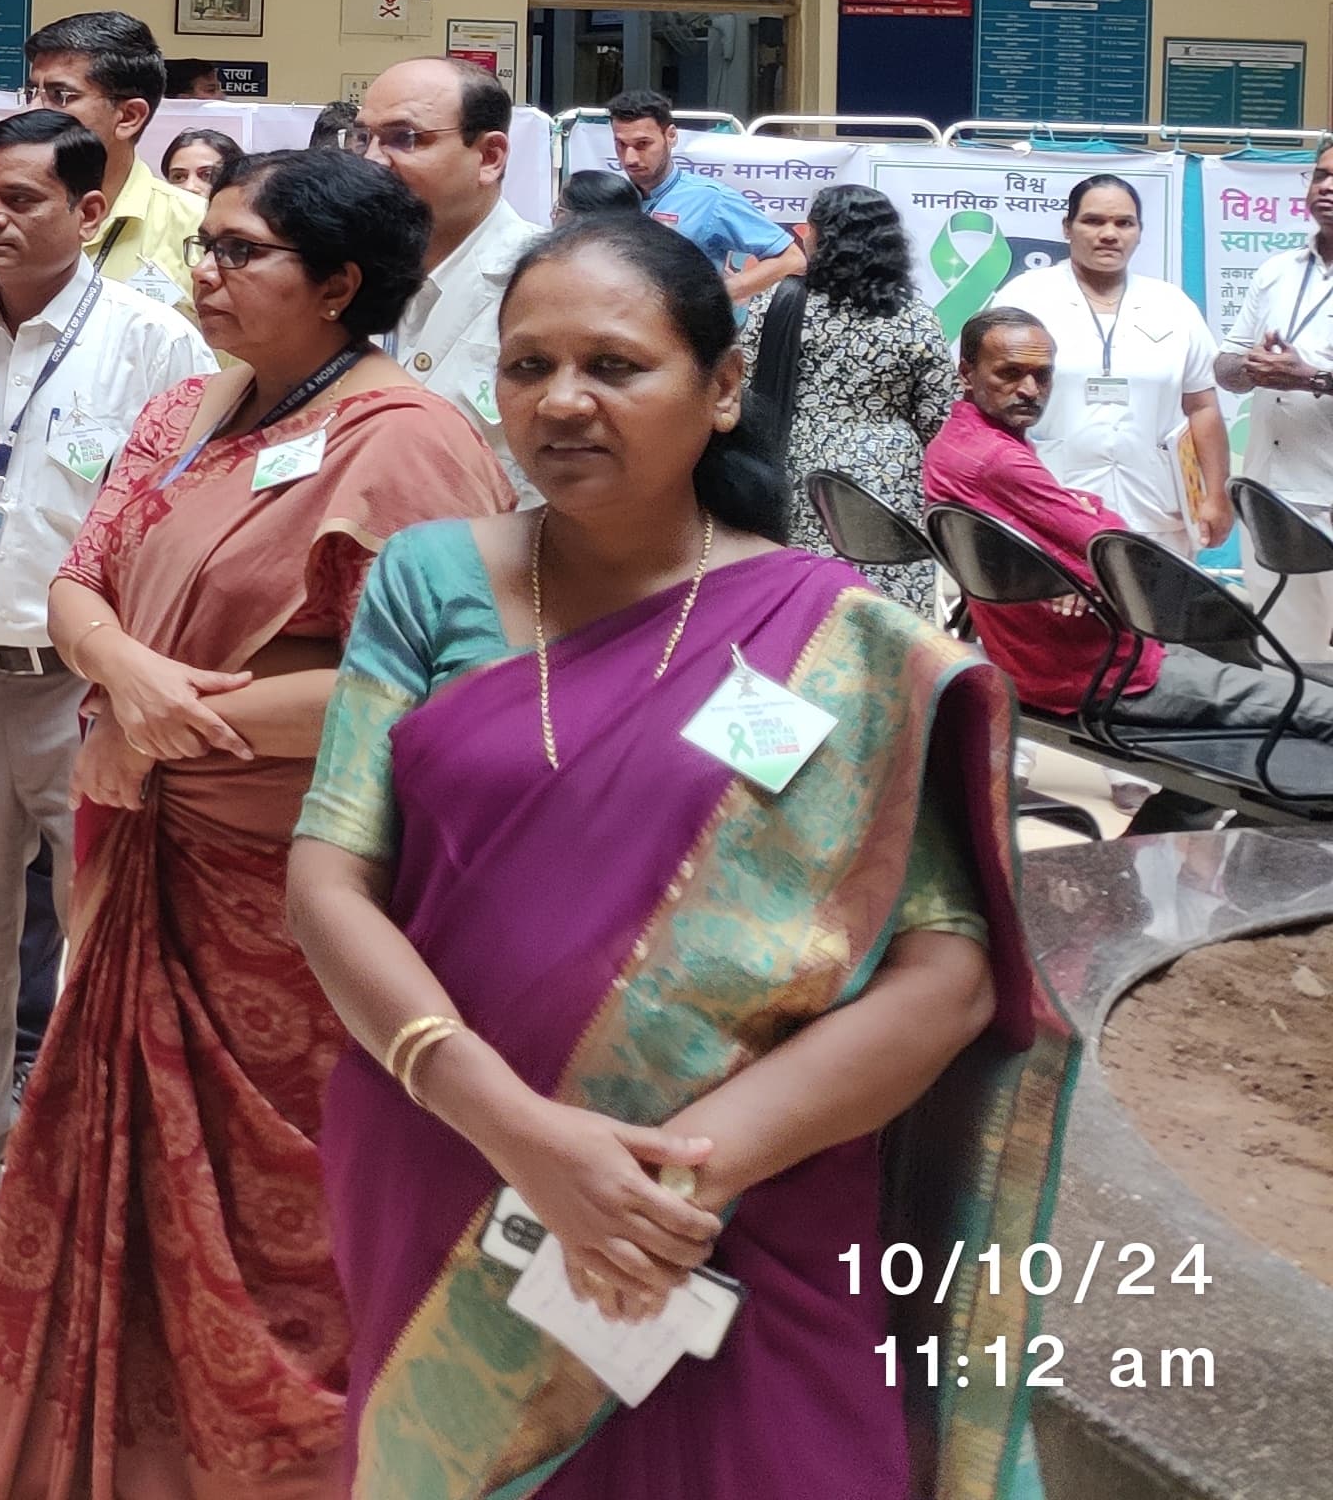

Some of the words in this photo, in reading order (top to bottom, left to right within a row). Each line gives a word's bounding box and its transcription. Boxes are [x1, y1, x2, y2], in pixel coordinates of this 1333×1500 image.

[223, 69, 253, 80] राखा
[733, 159, 837, 180] मानसिक
[1005, 172, 1046, 194] विश्व
[912, 190, 999, 210] मानसिक
[1220, 188, 1280, 224] विश्व
[52, 327, 75, 362] COLLEGE
[313, 351, 356, 385] HOSPITAL
